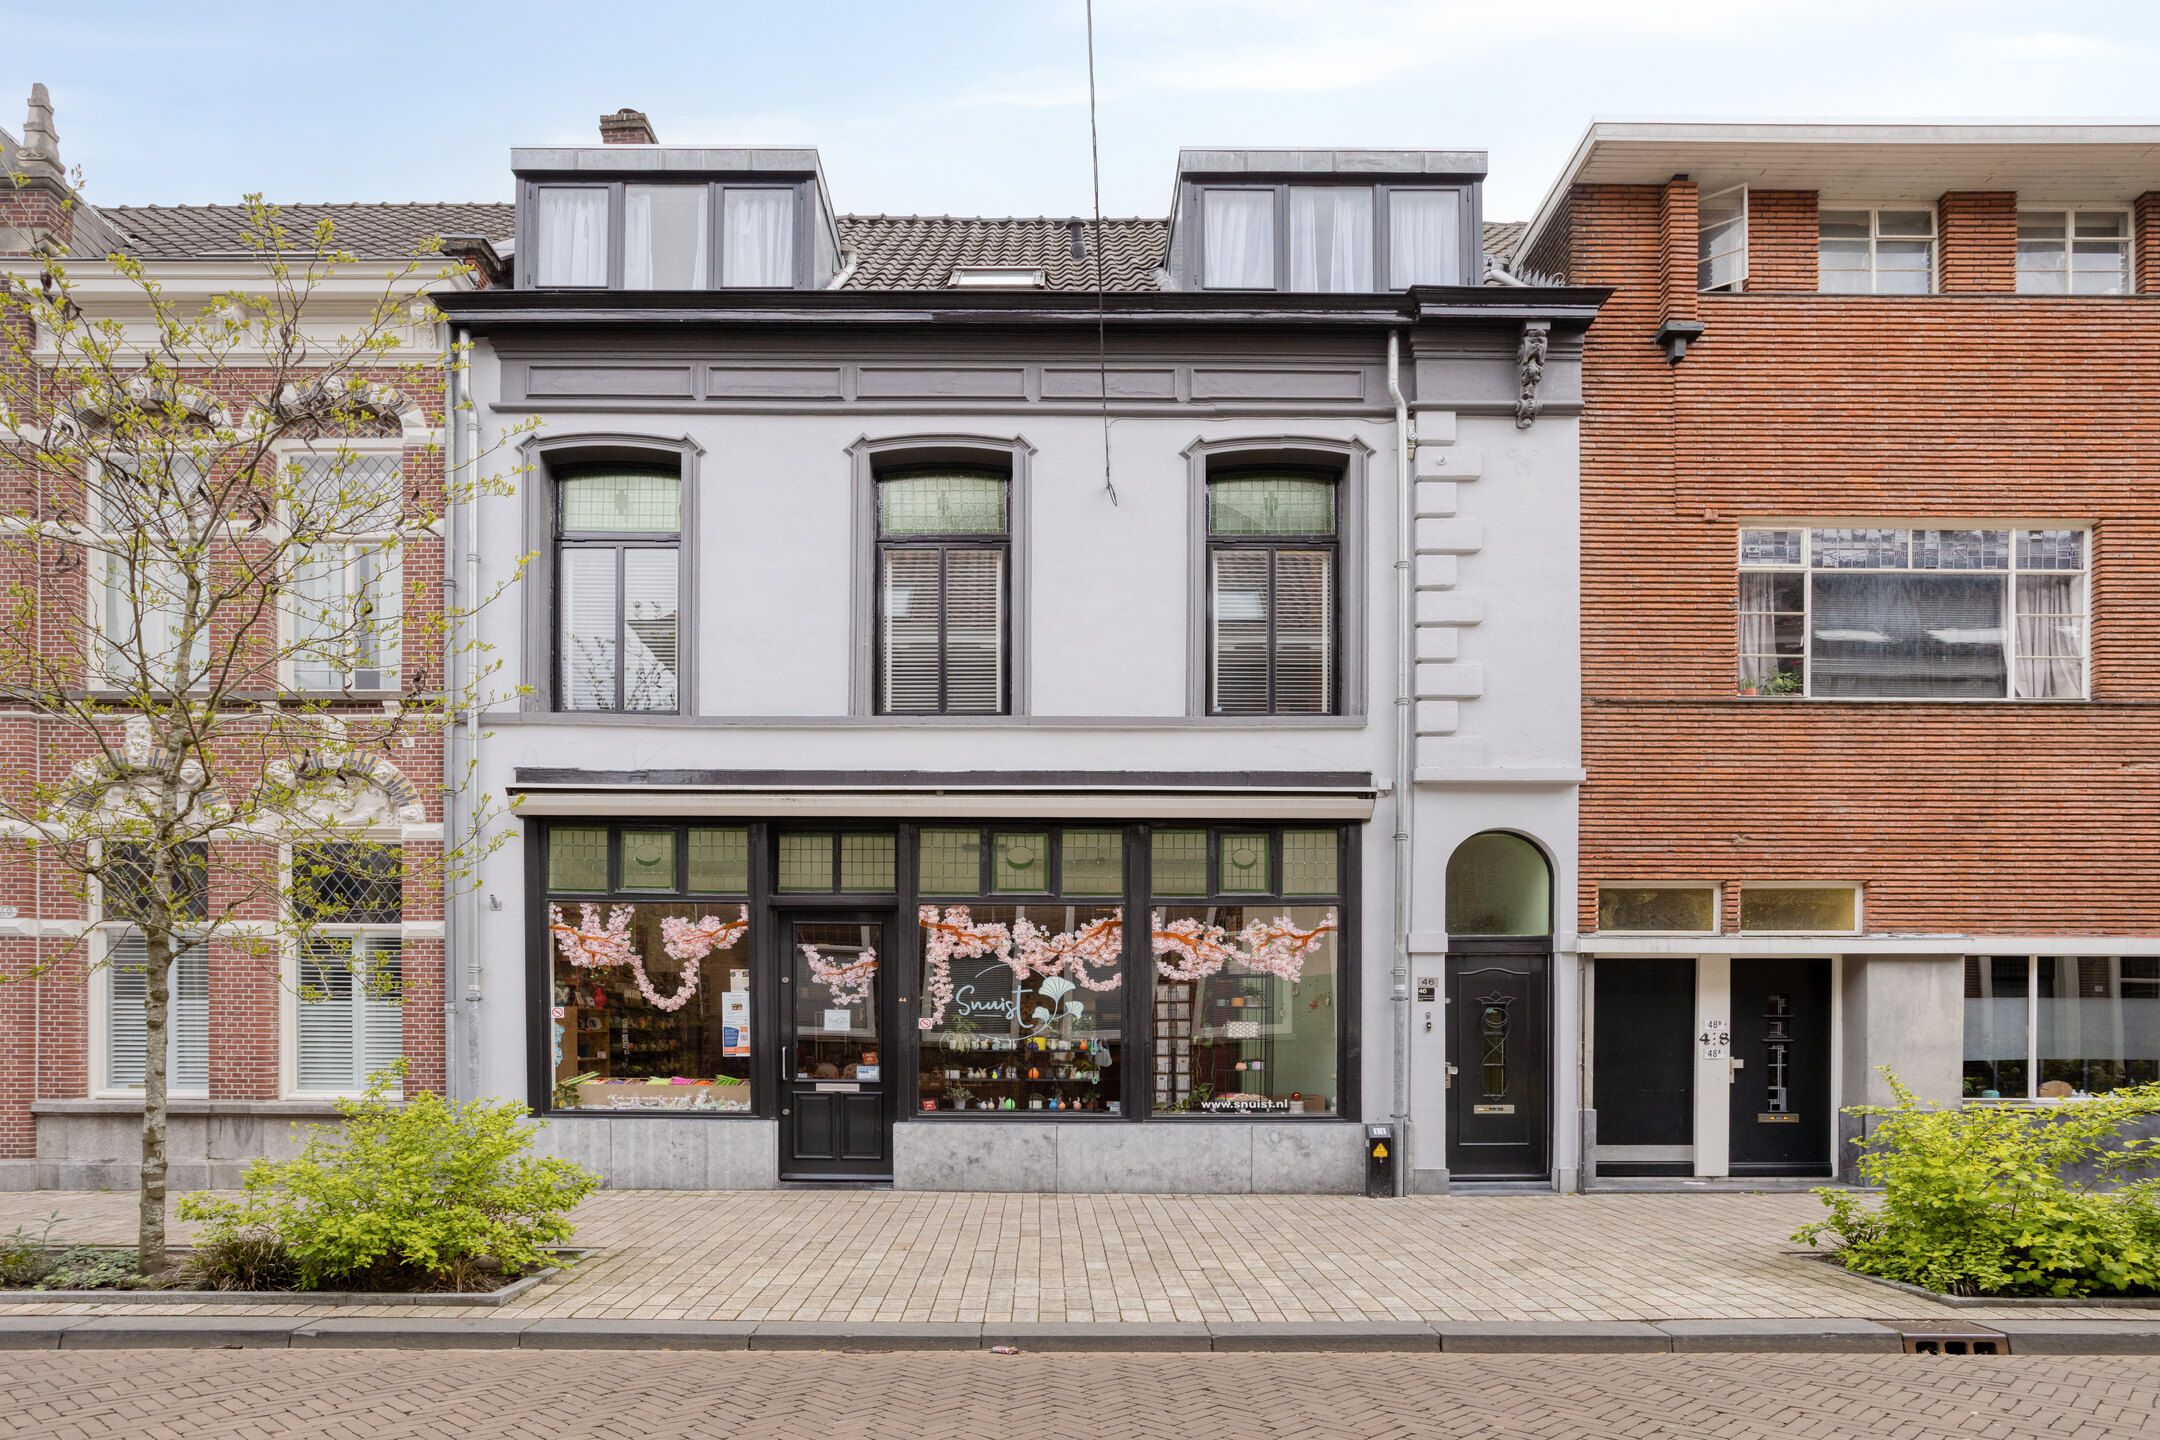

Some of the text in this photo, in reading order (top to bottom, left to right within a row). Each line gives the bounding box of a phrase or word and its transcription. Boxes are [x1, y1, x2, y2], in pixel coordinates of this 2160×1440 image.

[1421, 978, 1435, 986] 46
[956, 984, 1034, 1029] Snuist
[1201, 1098, 1288, 1109] www.snuist.nl
